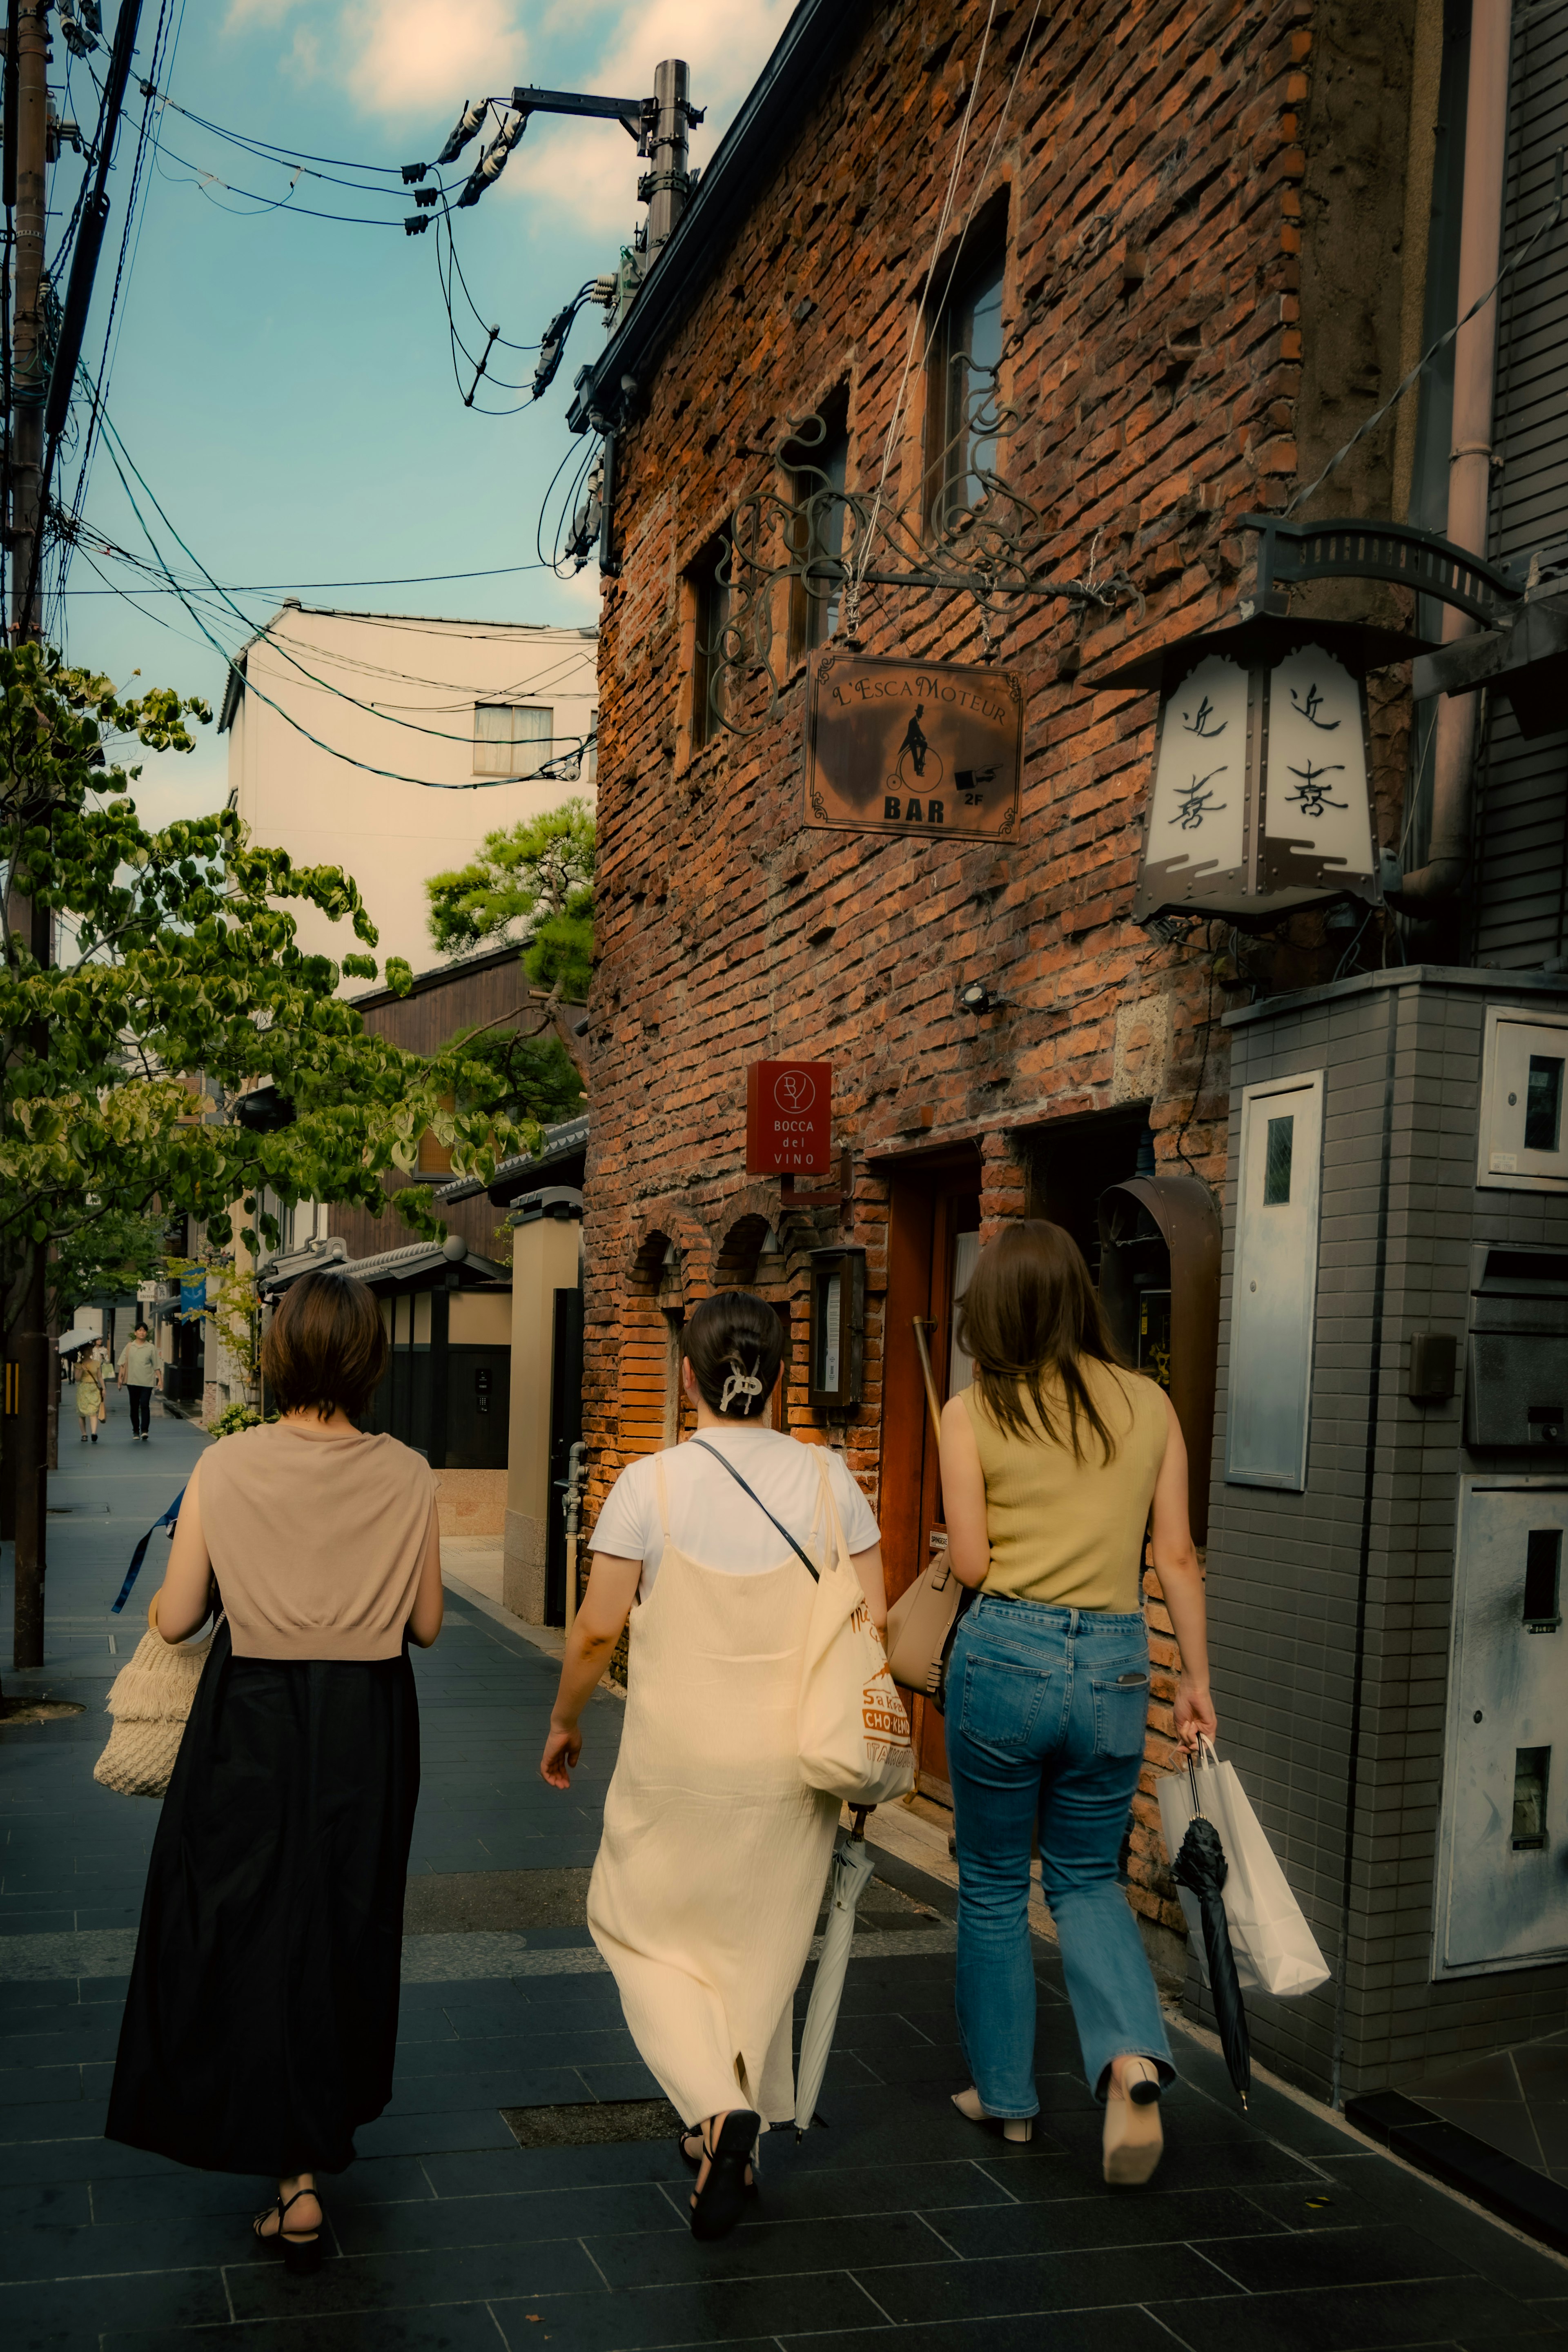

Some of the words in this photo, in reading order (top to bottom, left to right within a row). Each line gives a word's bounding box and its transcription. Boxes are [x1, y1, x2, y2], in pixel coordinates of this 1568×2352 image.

[964, 793, 984, 806] 2F
[884, 795, 944, 824] BAR
[774, 1120, 814, 1132] BOCCA
[782, 1137, 804, 1148] del
[774, 1154, 814, 1165] VINO
[931, 1536, 947, 1545] SPINGERE
